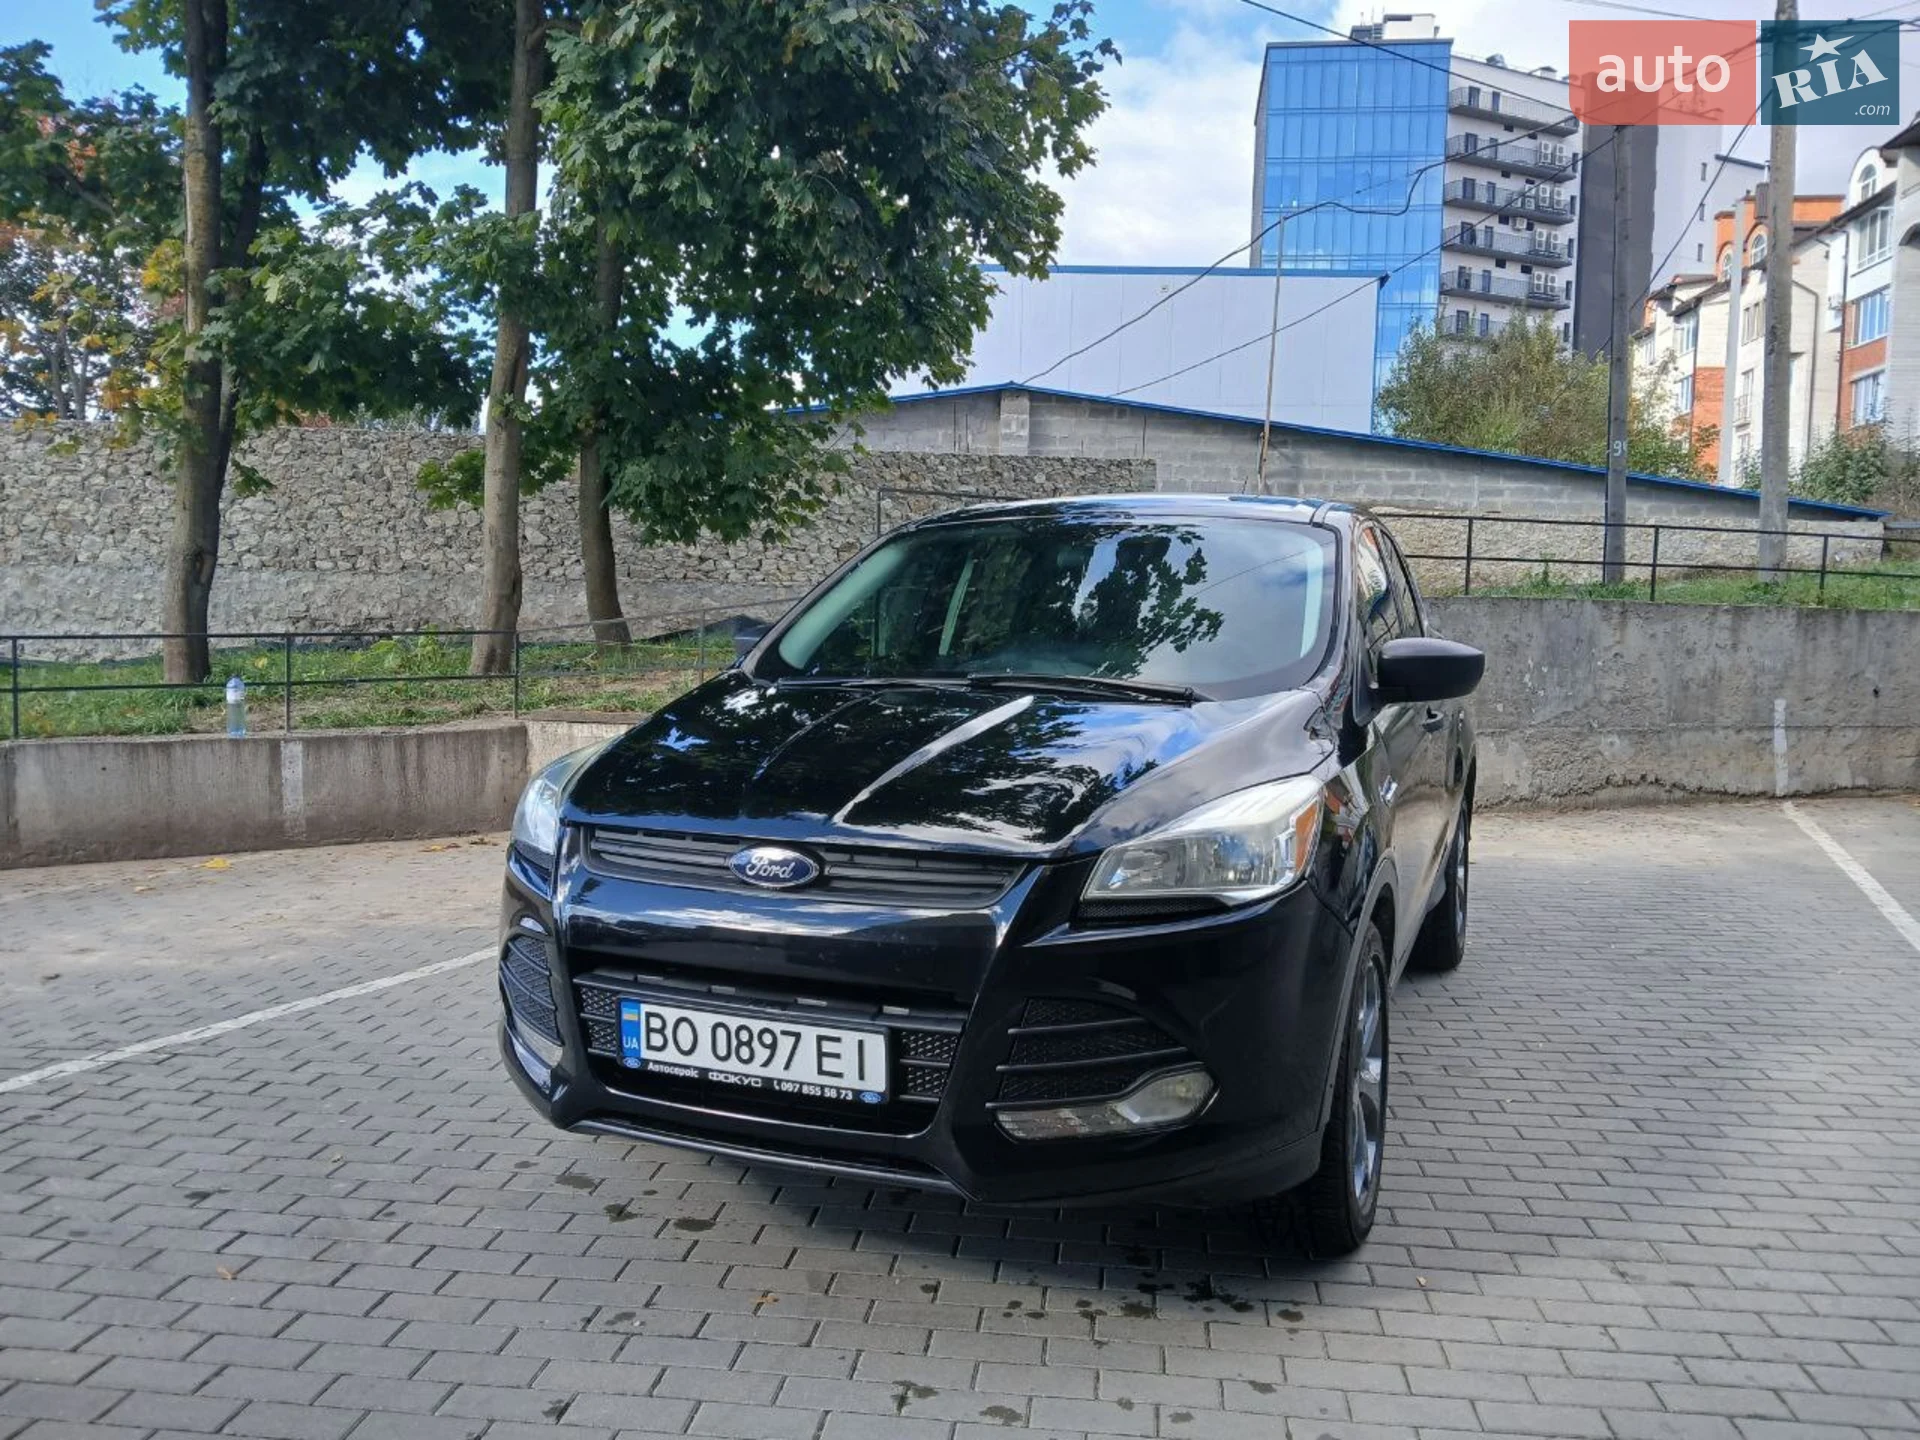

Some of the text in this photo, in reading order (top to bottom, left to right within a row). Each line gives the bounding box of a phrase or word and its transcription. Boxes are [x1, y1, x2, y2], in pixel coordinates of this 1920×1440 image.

[746, 855, 796, 878] Ford
[623, 1035, 639, 1049] UA
[645, 1010, 865, 1081] BO 0897 EI
[781, 1081, 799, 1093] 097
[840, 1090, 853, 1100] 73
